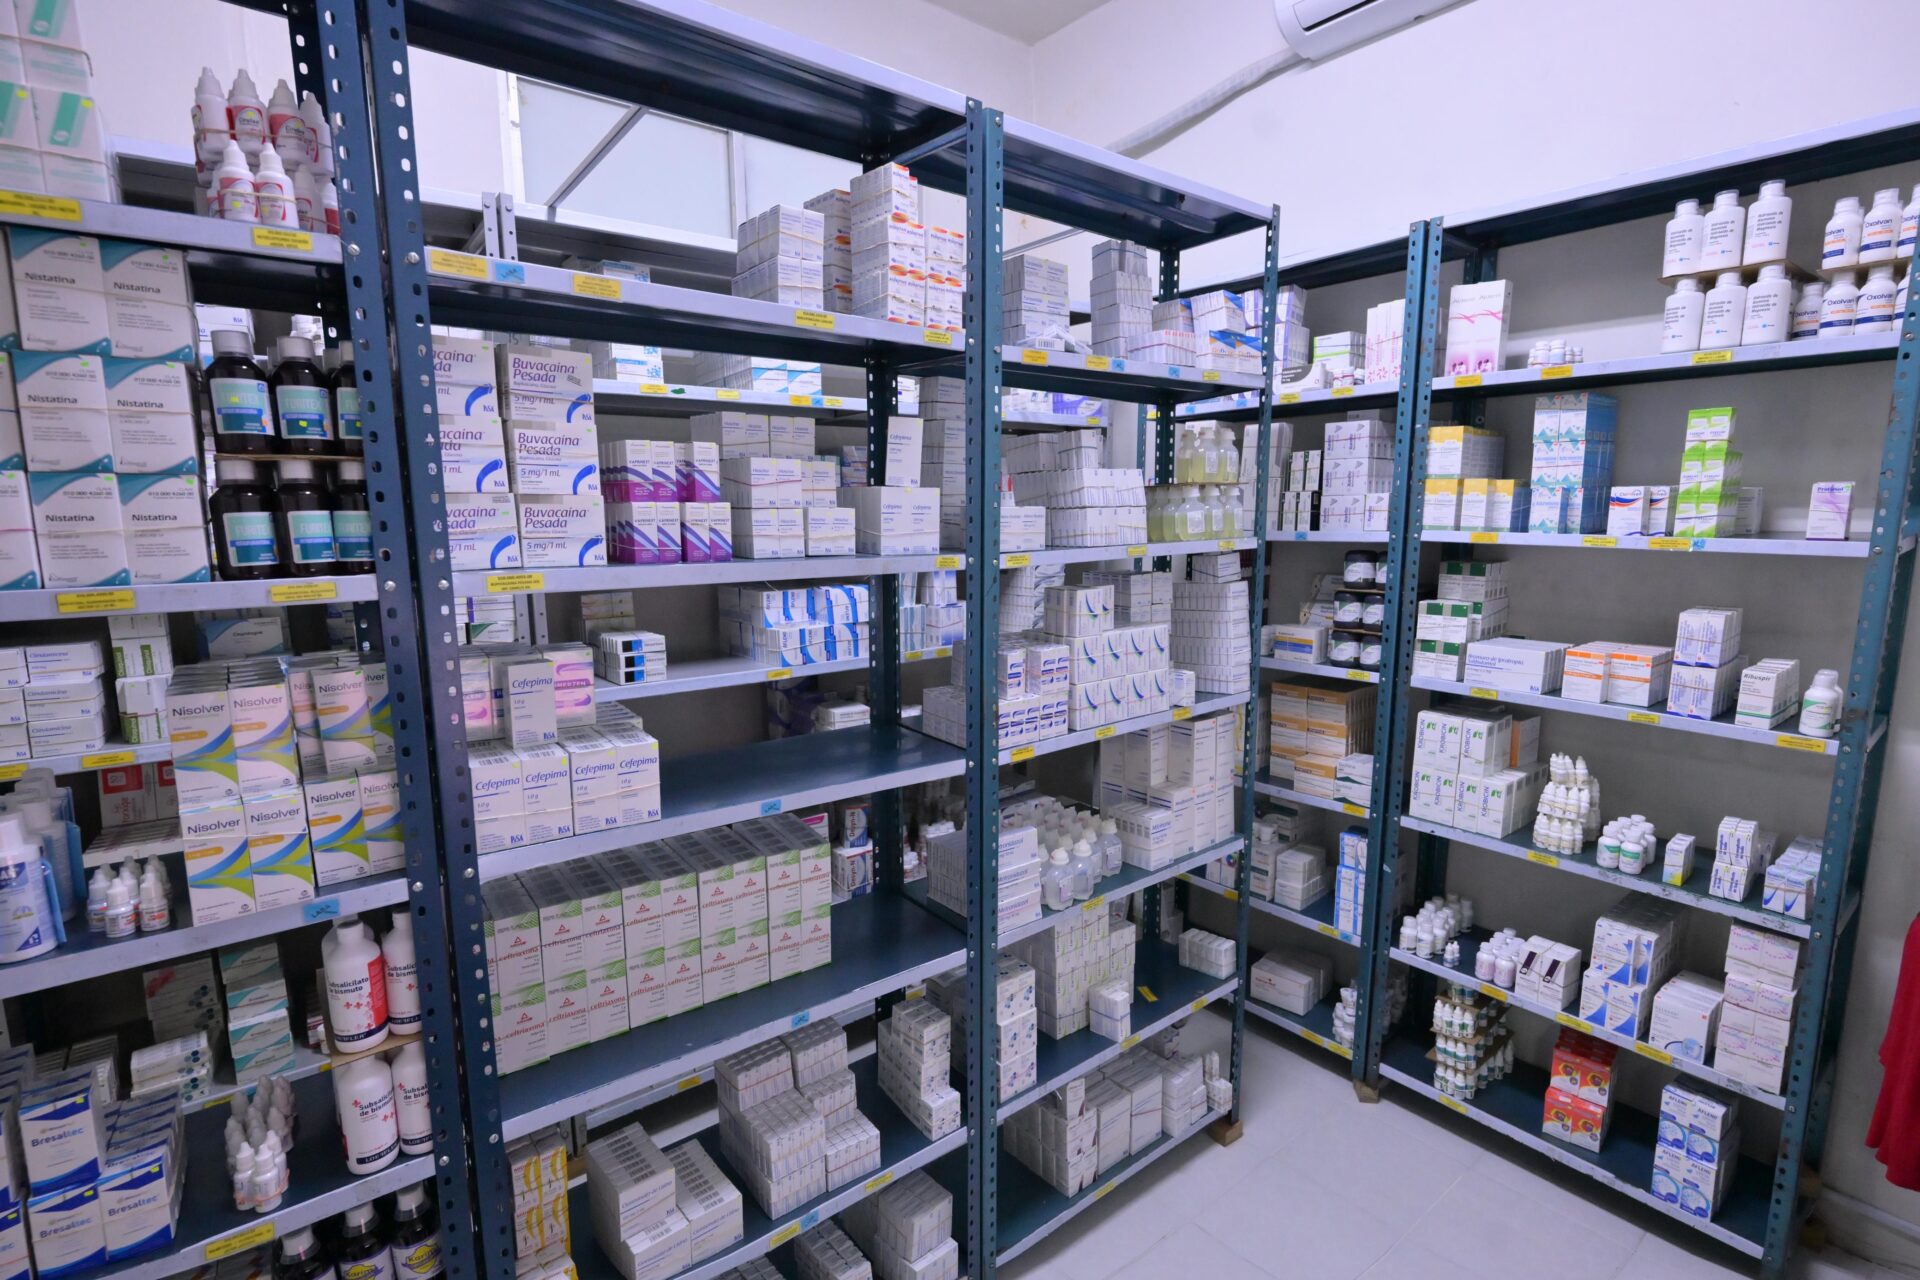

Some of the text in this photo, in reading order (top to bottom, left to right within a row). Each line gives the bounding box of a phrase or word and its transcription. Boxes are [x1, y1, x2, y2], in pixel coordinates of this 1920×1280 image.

[24, 272, 76, 285] Nistatina
[114, 282, 161, 294] Nistatina
[513, 369, 556, 384] Pesada
[28, 394, 78, 404] Nistatina
[117, 399, 164, 409] Nistatina
[518, 433, 580, 447] Buvacaina
[46, 514, 95, 522] Nistatina
[132, 514, 178, 522] Nistatina
[524, 506, 587, 518] Buvacaina
[525, 518, 568, 529] Pesada
[318, 681, 362, 694] Nisolver
[512, 677, 553, 689] Cefepima
[233, 696, 283, 709] Nisolver
[172, 703, 225, 717] Nisolver
[576, 763, 615, 775] Cefepima
[620, 756, 658, 769] Cefepima
[525, 770, 568, 783] Cefepima
[475, 776, 520, 792] Cefepima
[310, 789, 356, 804] Nisolver
[250, 808, 301, 823] Nisolver
[187, 818, 241, 835] Nisolver
[31, 1127, 85, 1148] Bresaltec
[108, 1194, 158, 1217] Bresaltec
[40, 1216, 94, 1238] Bresaltec
